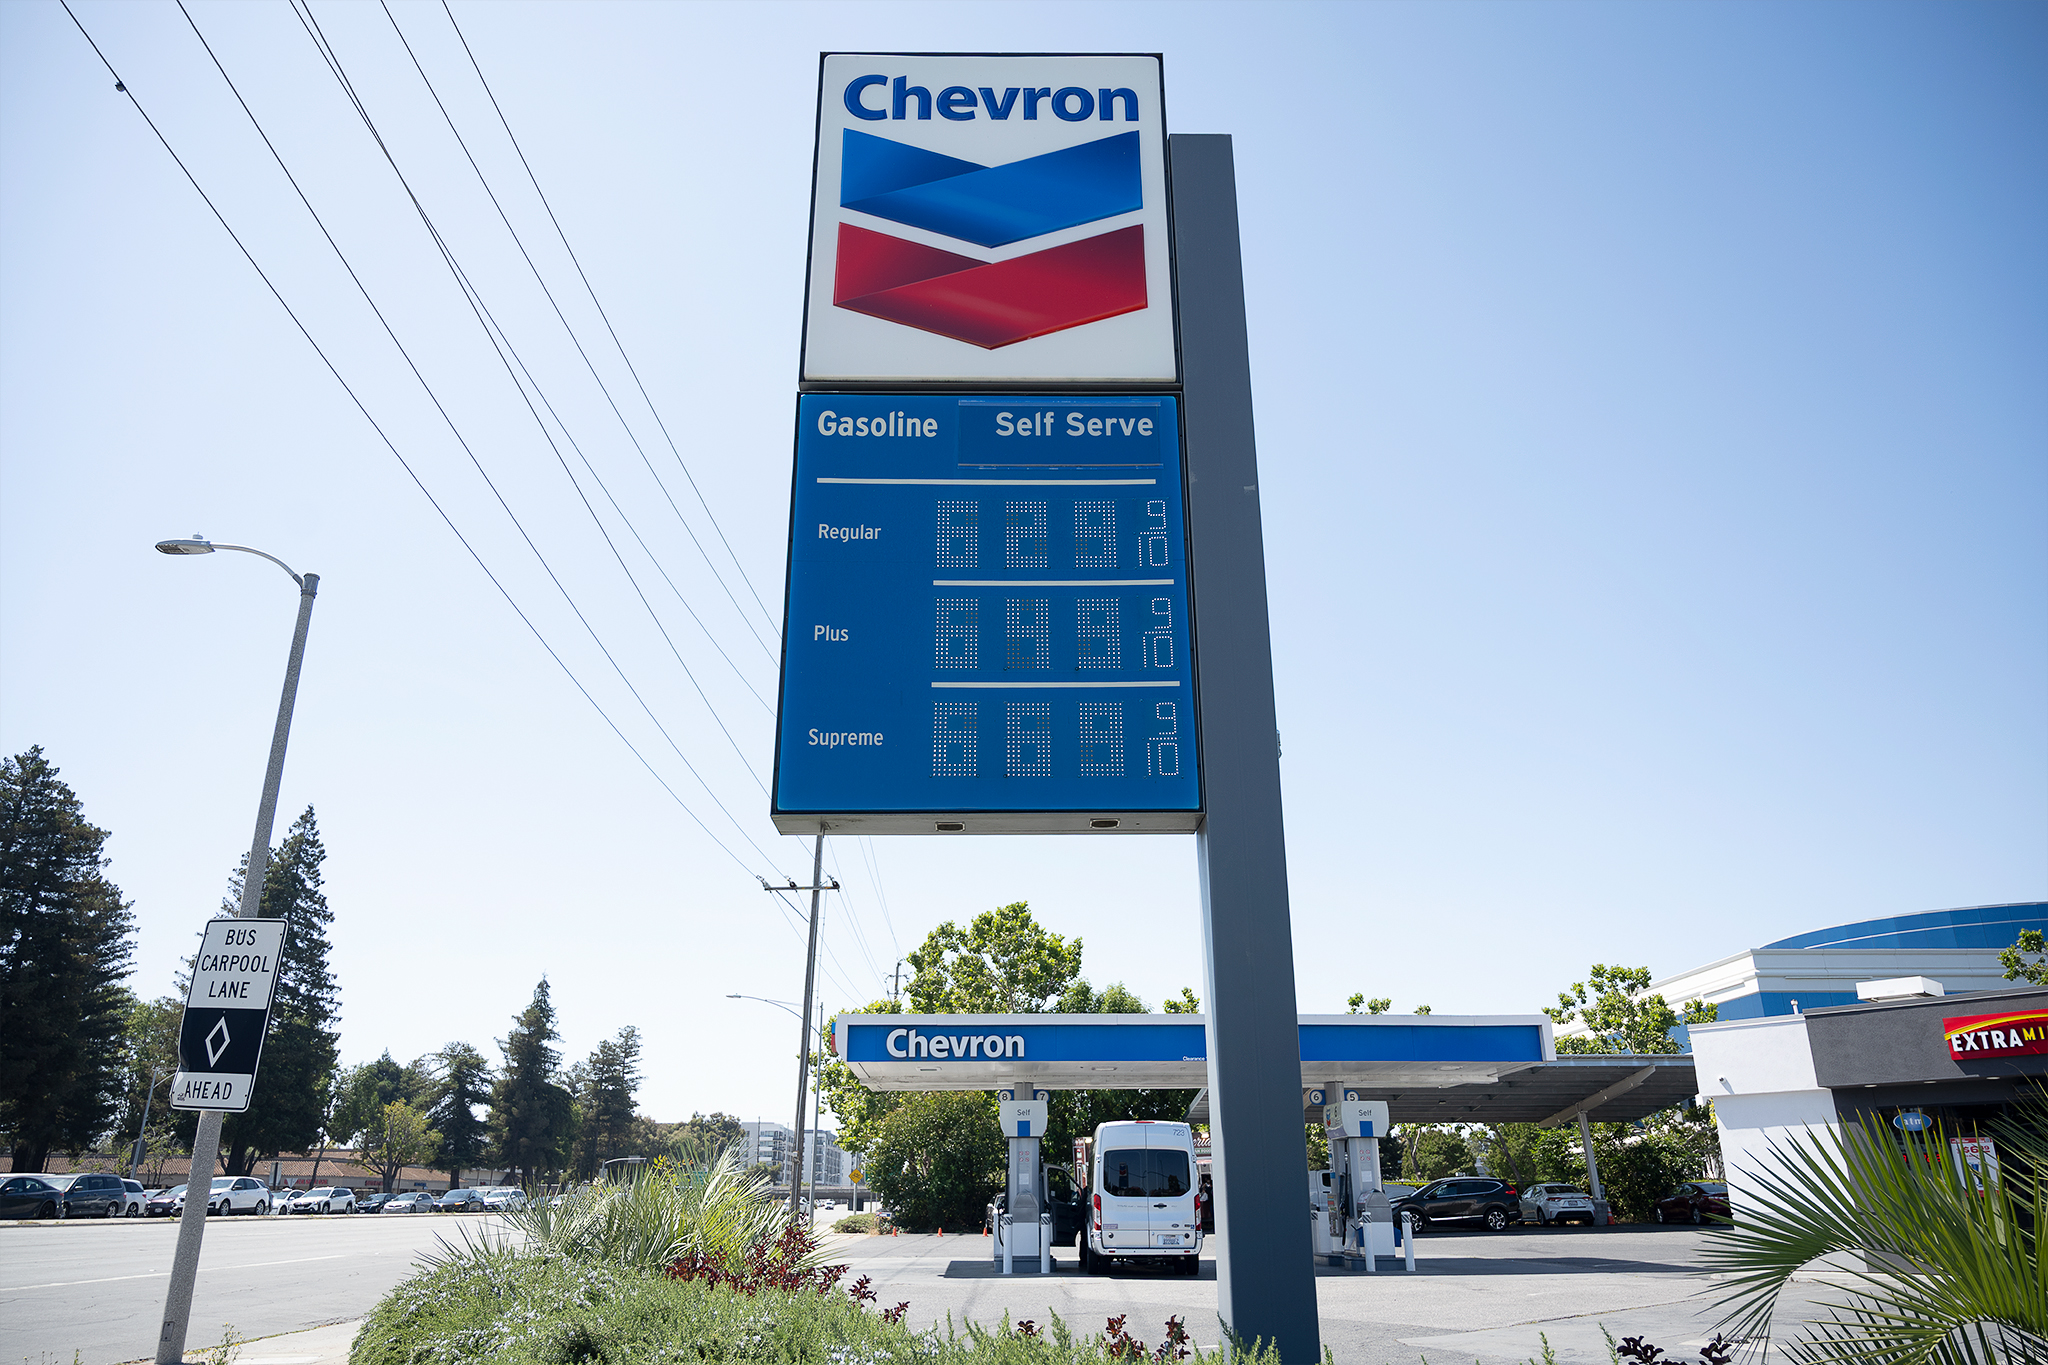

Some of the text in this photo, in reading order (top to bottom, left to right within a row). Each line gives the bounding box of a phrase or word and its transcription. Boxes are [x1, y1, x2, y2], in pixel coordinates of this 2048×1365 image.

[844, 74, 1140, 122] Chevron
[817, 410, 1154, 437] Gasoline Self Serve
[818, 523, 882, 543] Regular
[813, 624, 849, 642] Plus
[808, 728, 884, 749] Supreme
[225, 929, 257, 946] BUS
[201, 954, 270, 973] CARPOOL
[208, 980, 251, 999] LANE
[886, 1028, 1025, 1059] Chevron
[185, 1080, 233, 1100] AHEAD
[1001, 1093, 1008, 1101] 8
[1040, 1093, 1046, 1101] 7
[1313, 1093, 1320, 1101] 6
[1350, 1093, 1356, 1101] 5
[1016, 1108, 1031, 1116] Self
[1358, 1109, 1372, 1117] Self
[1172, 1128, 1185, 1137] 723
